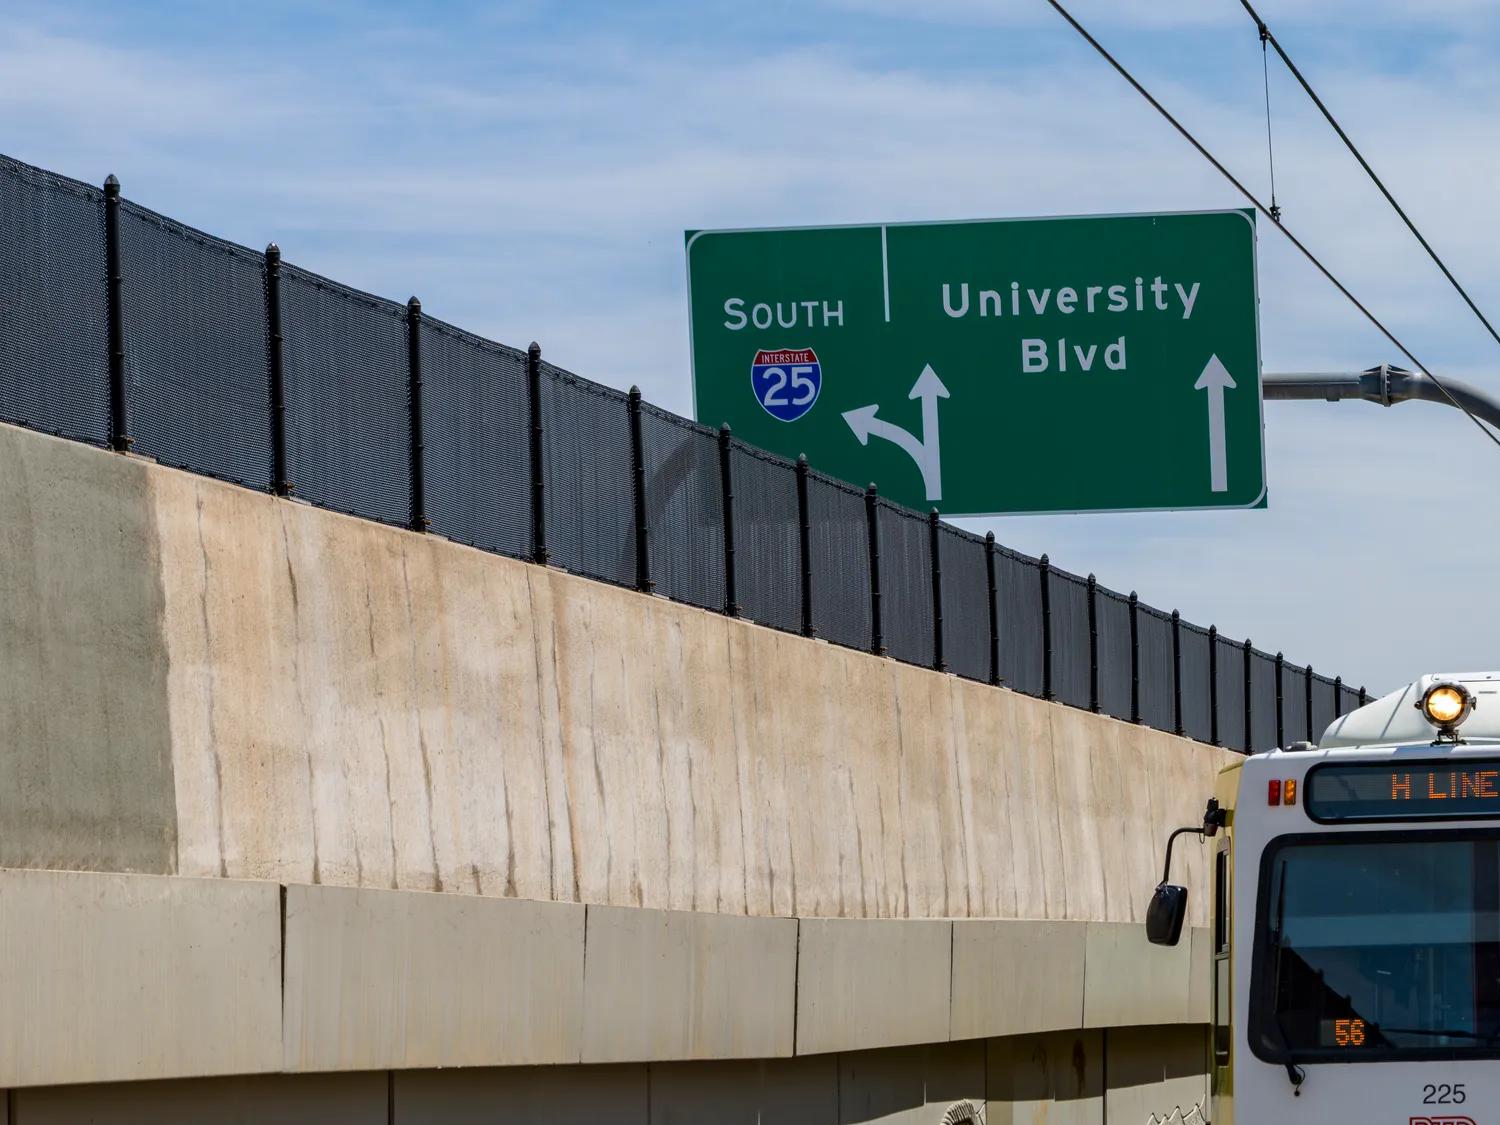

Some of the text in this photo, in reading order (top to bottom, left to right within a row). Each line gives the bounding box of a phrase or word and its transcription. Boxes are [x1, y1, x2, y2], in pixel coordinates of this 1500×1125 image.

[941, 276, 1200, 319] University
[723, 298, 845, 331] SOUTH
[761, 352, 809, 364] INTERSTATE
[1021, 336, 1127, 374] Blvd
[762, 367, 814, 405] 25
[1392, 770, 1500, 800] H LINE
[1335, 1019, 1365, 1046] 56
[1422, 1084, 1467, 1105] 225
